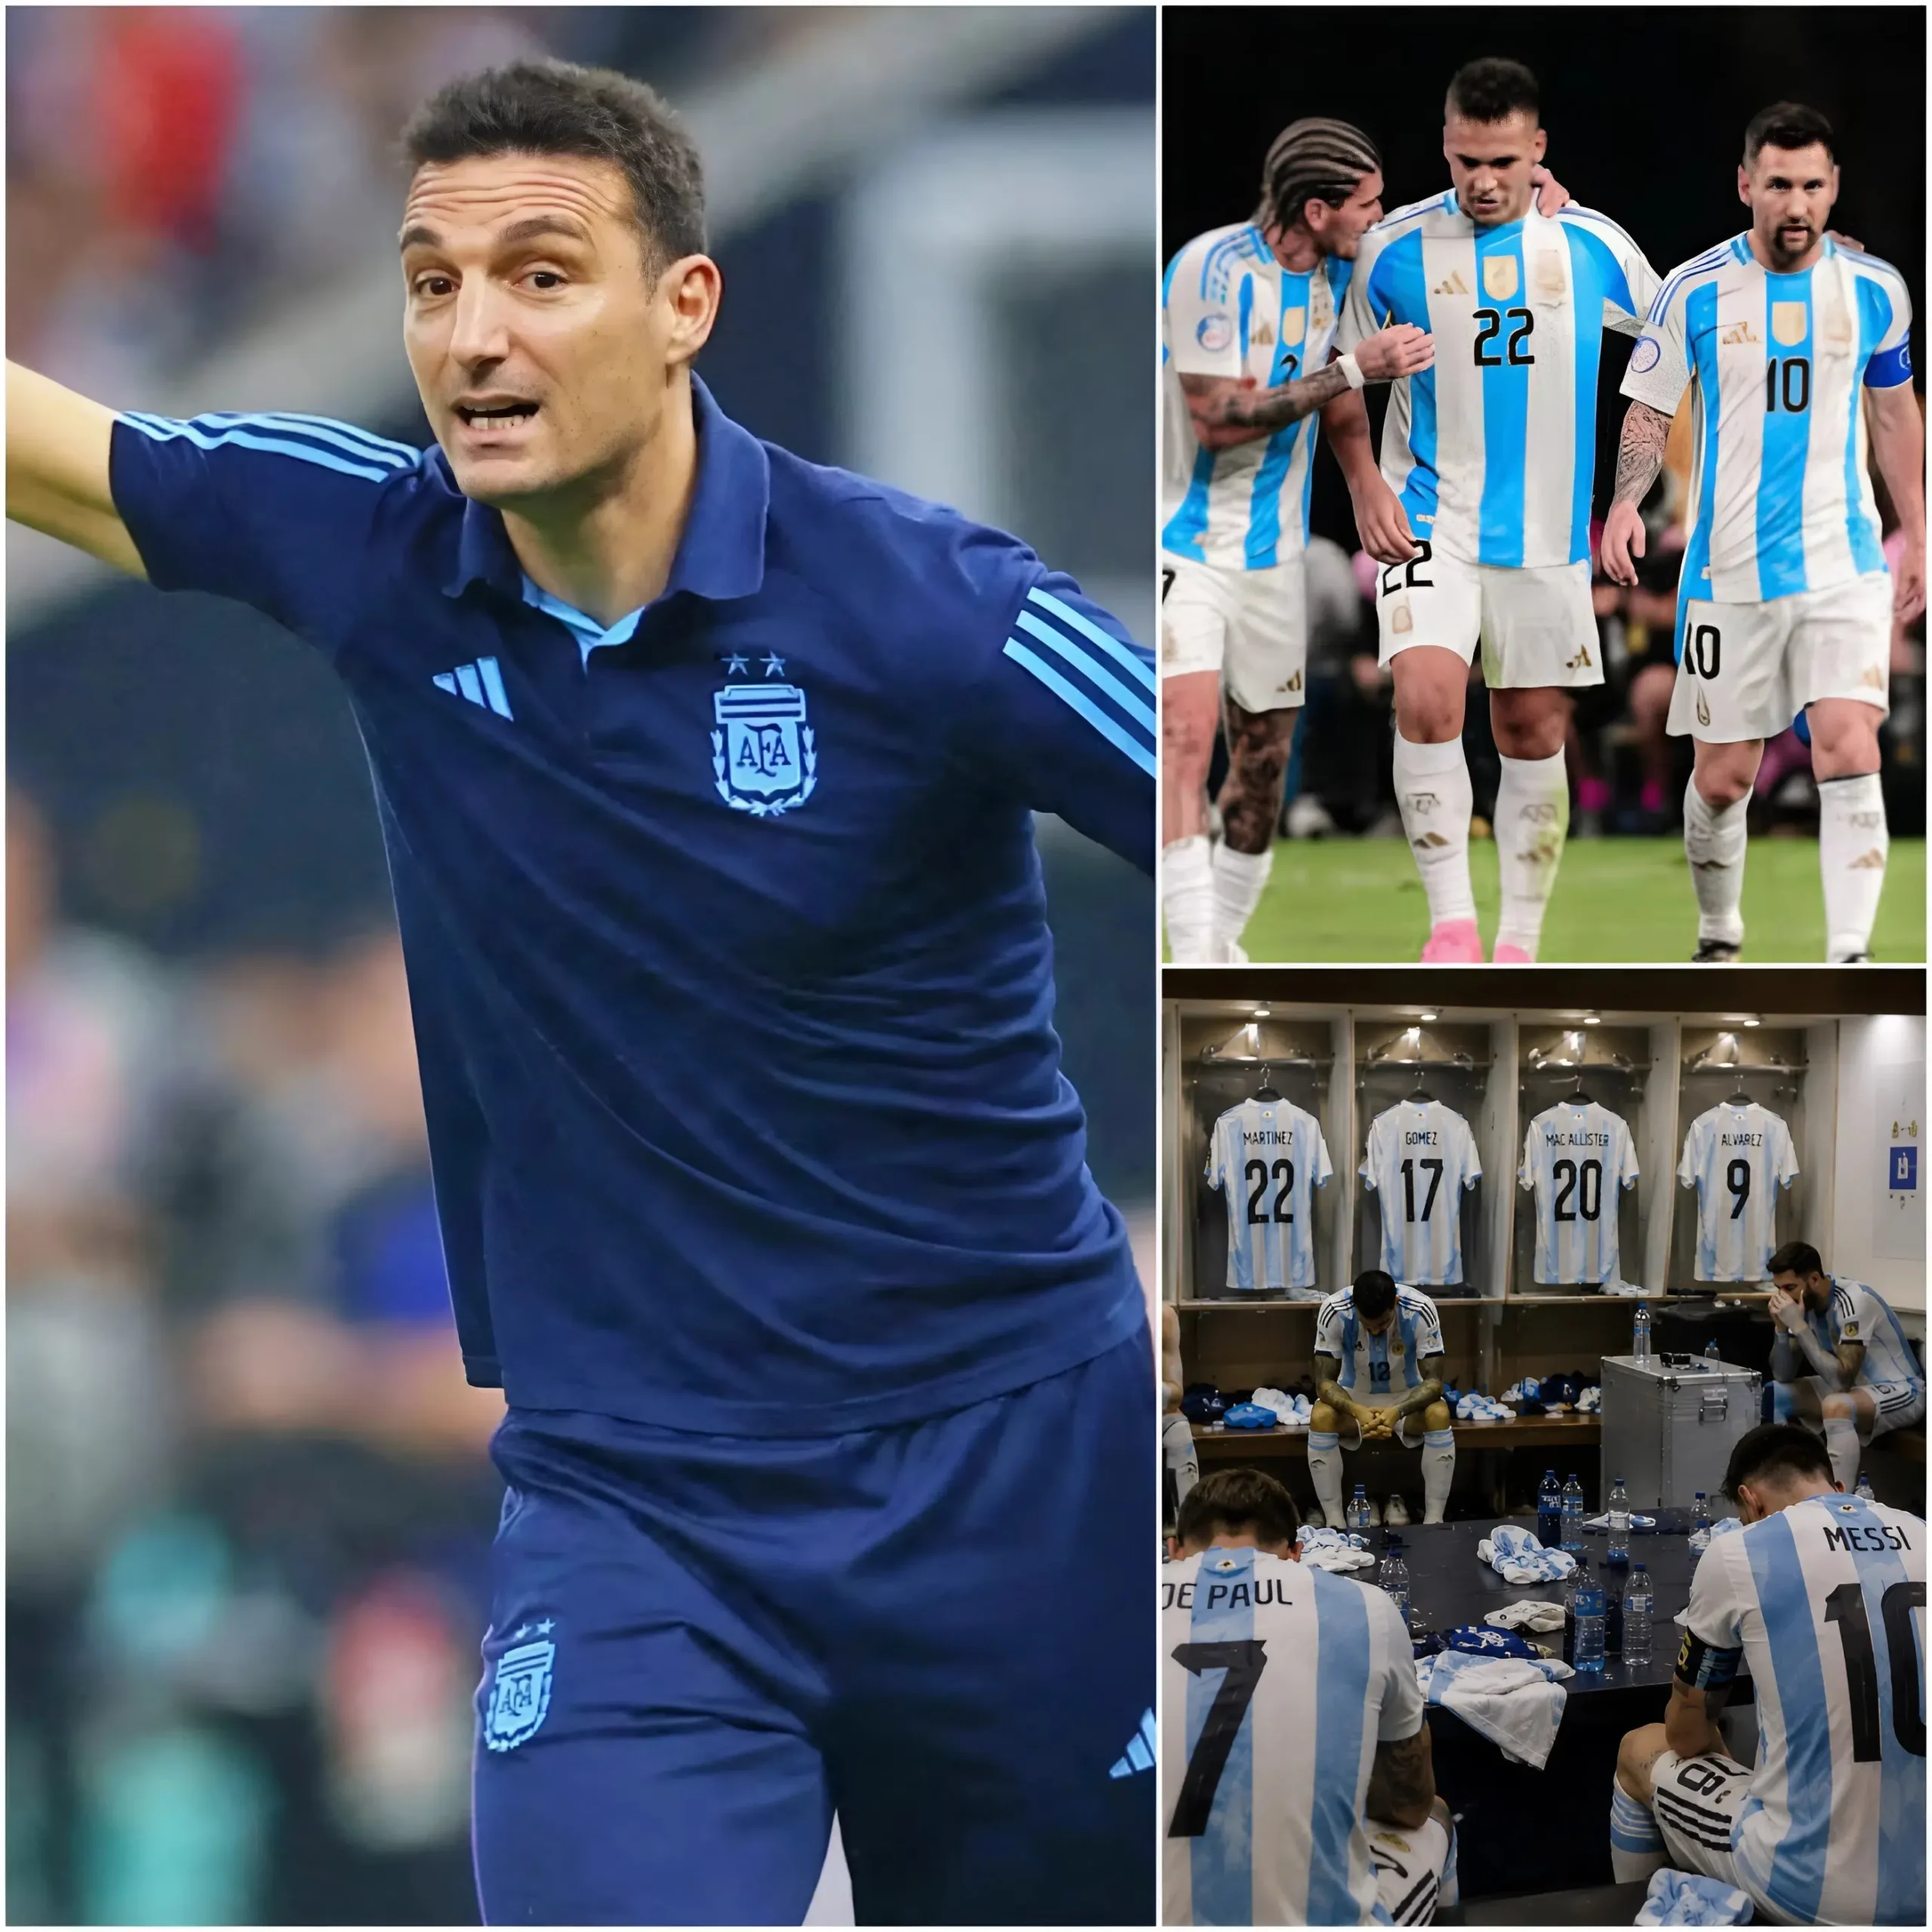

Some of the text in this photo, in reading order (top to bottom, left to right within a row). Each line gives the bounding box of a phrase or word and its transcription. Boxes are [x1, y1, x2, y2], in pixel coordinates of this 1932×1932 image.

[1472, 308, 1535, 366] 22
[1767, 358, 1809, 413] 10
[736, 722, 792, 778] AFA
[1243, 1131, 1293, 1145] MARTINEZ
[1405, 1132, 1438, 1146] GOMEZ
[1546, 1134, 1565, 1146] MAC
[1721, 1134, 1763, 1146] ALVAREZ
[1244, 1158, 1294, 1224] 22
[1401, 1158, 1443, 1222] 17
[1552, 1159, 1602, 1221] 20
[1727, 1159, 1751, 1220] 9
[1368, 1361, 1391, 1382] 12
[1823, 1525, 1912, 1551] MESSI
[1208, 1579, 1293, 1610] PAUL
[1824, 1582, 1927, 1762] 10
[1168, 1640, 1268, 1838] 7
